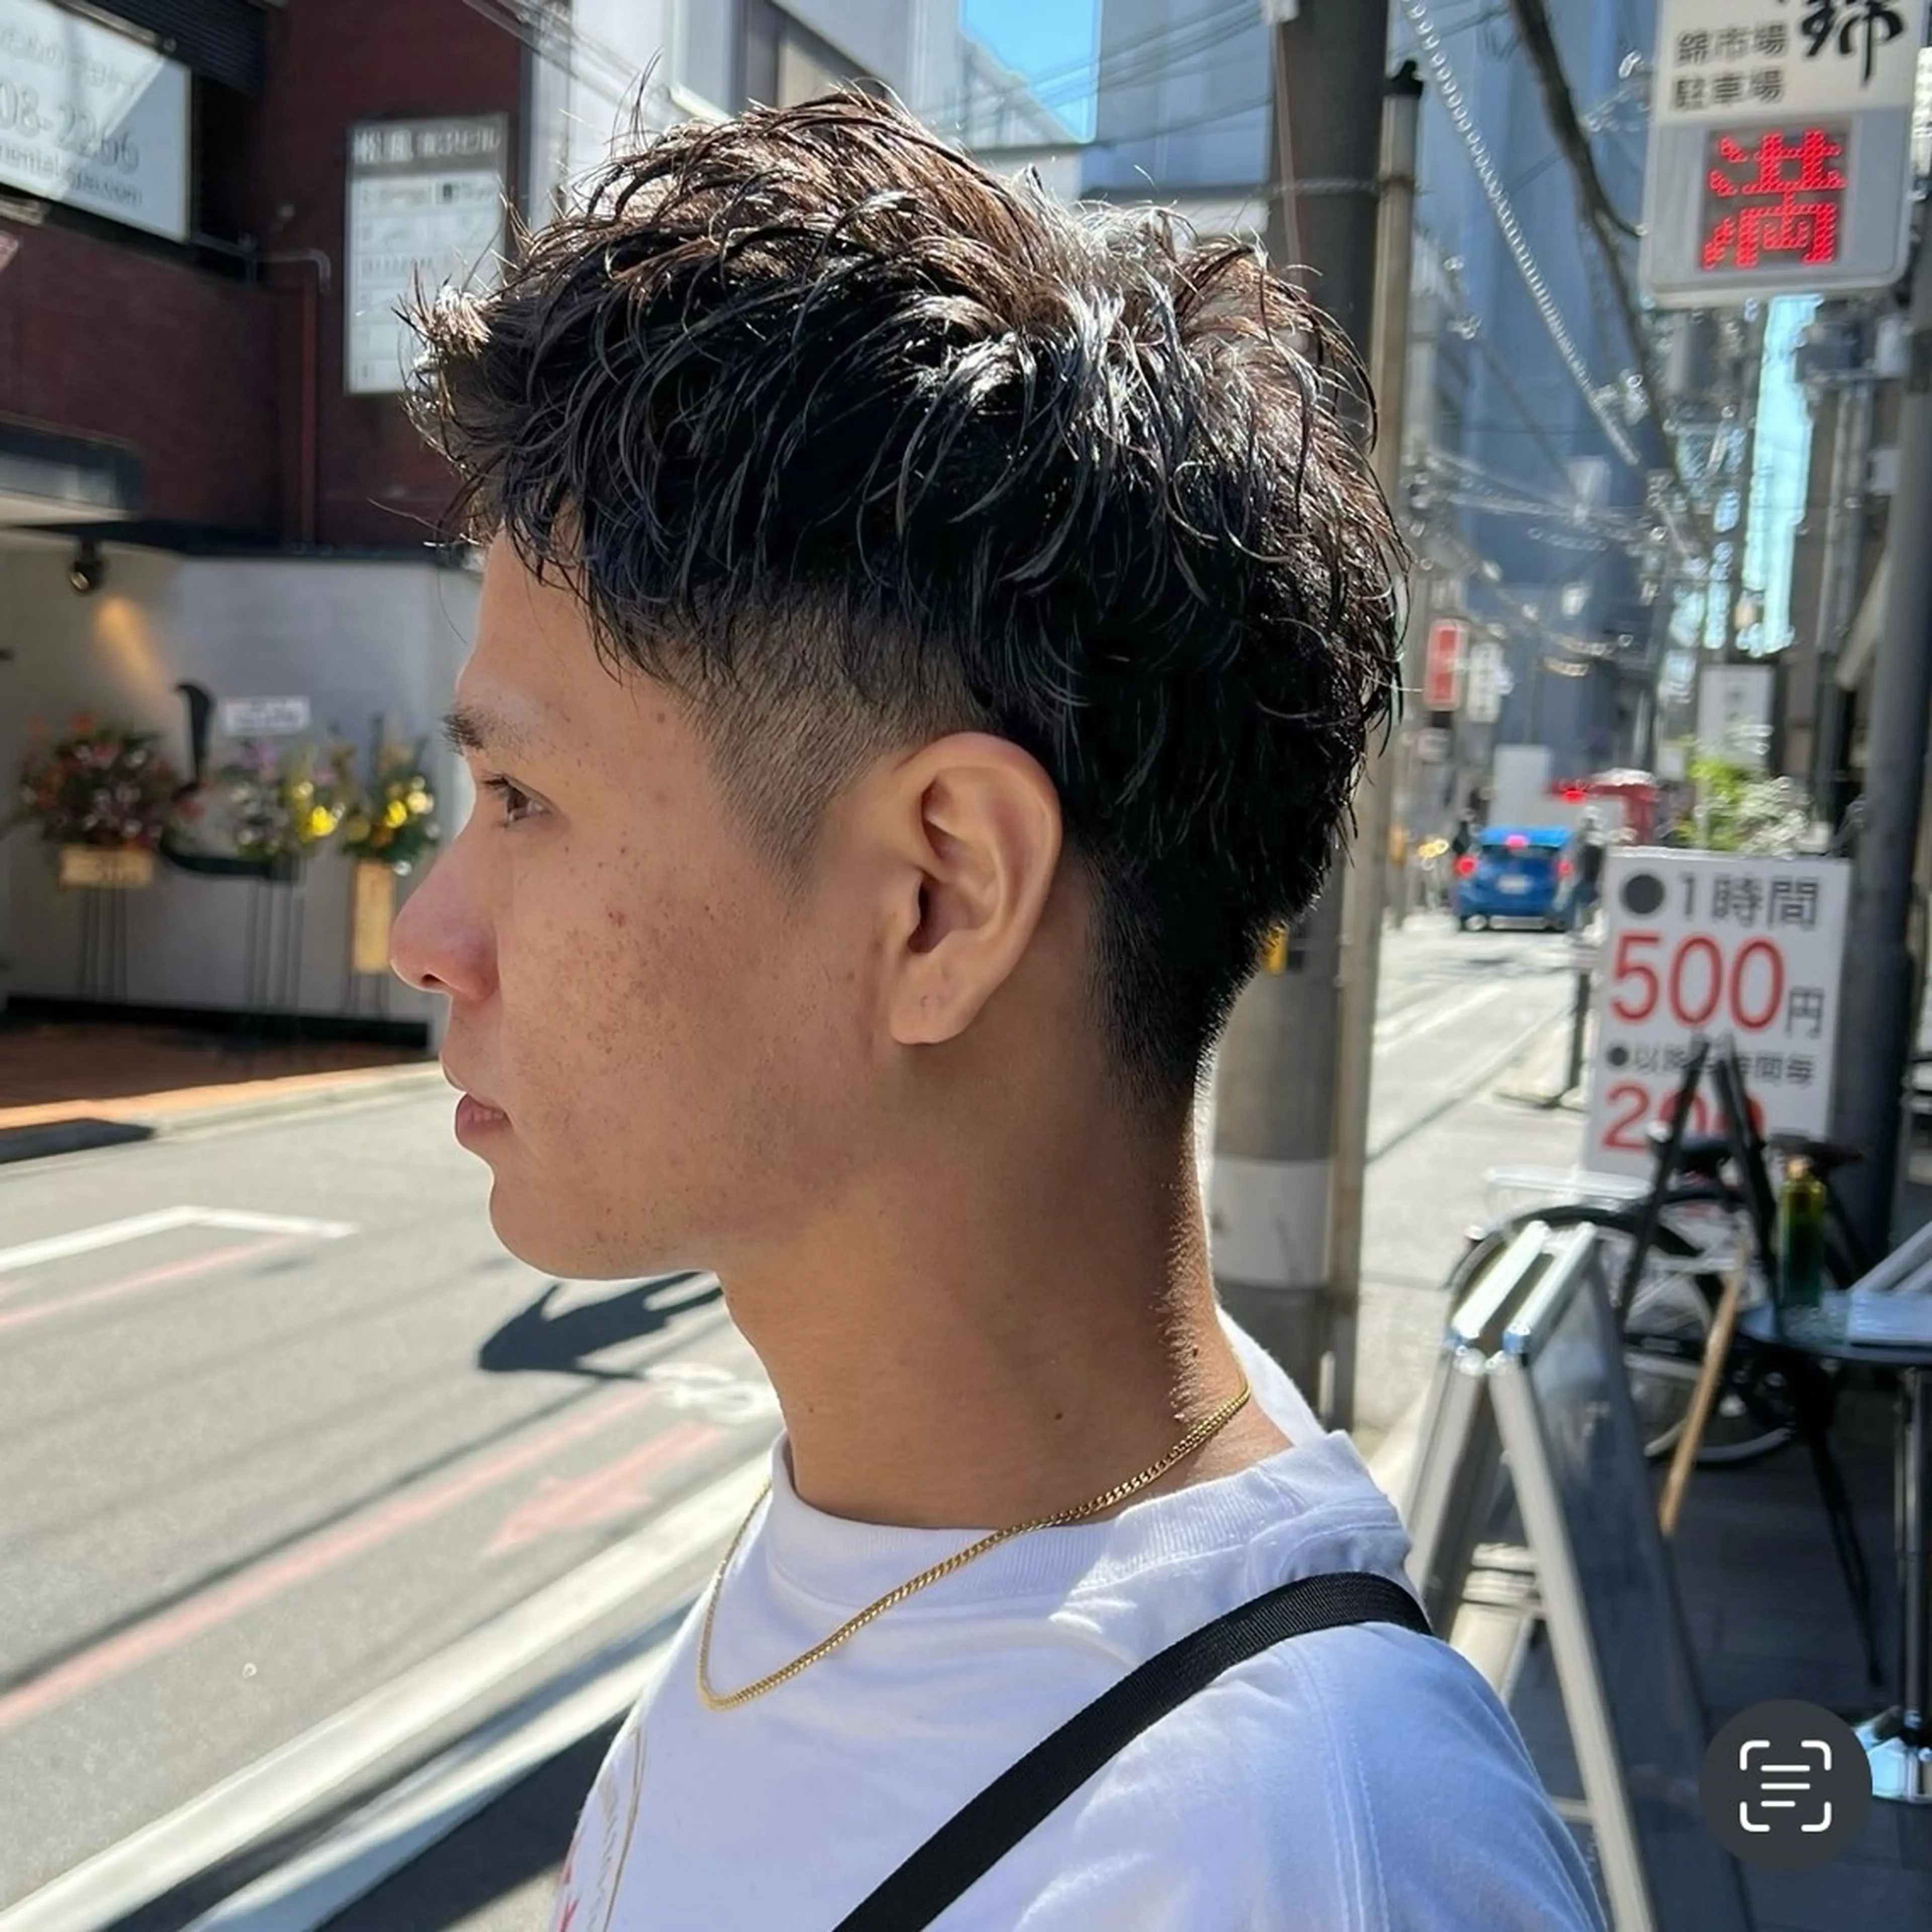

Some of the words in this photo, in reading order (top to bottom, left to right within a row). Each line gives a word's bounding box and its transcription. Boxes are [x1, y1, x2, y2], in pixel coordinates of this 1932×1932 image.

[1675, 69, 1783, 110] 駐車場
[1702, 128, 1848, 270] 満
